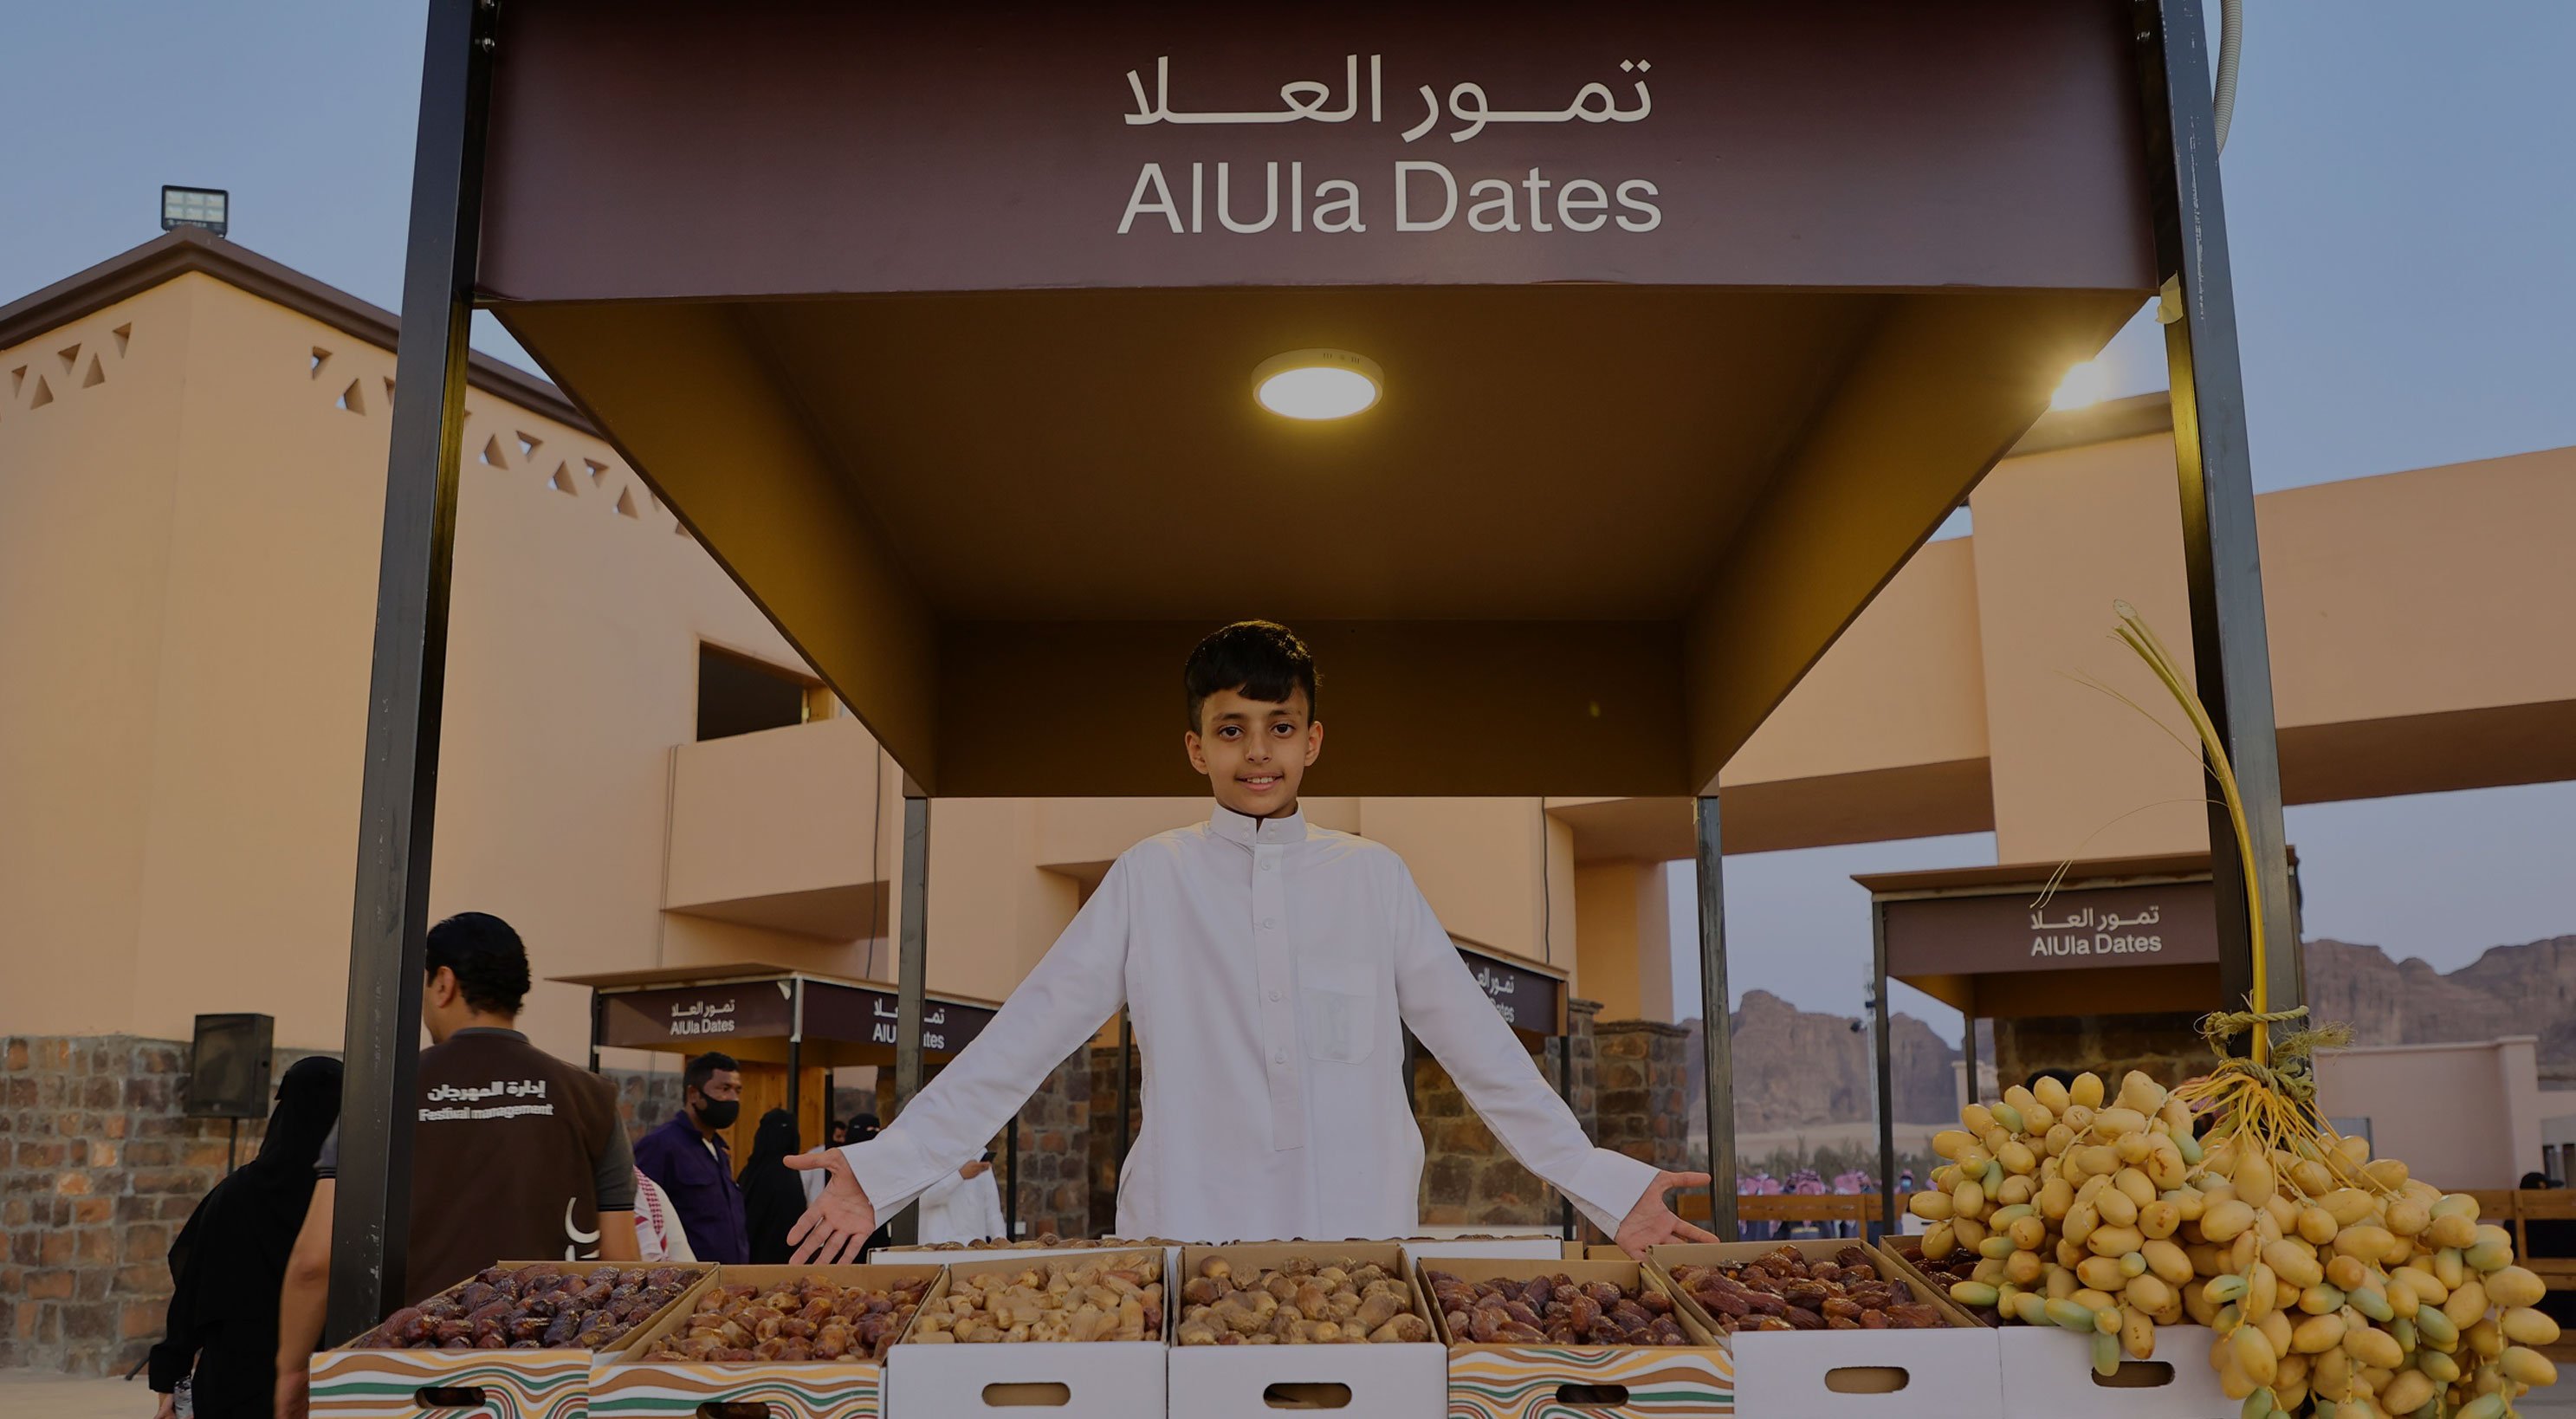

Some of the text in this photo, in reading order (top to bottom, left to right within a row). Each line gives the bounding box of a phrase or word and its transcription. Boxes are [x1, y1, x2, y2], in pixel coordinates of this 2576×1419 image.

[1124, 54, 1652, 143] تمور العلا
[1116, 161, 1661, 234] AlUla Dates
[2030, 905, 2159, 931] تمور العلا
[2030, 933, 2163, 956] AlUla Dates
[671, 999, 735, 1018] تمور العلا
[670, 1018, 735, 1035] AlUla Dates
[872, 1022, 945, 1049] AlU tes
[418, 1103, 554, 1122] Festival management
